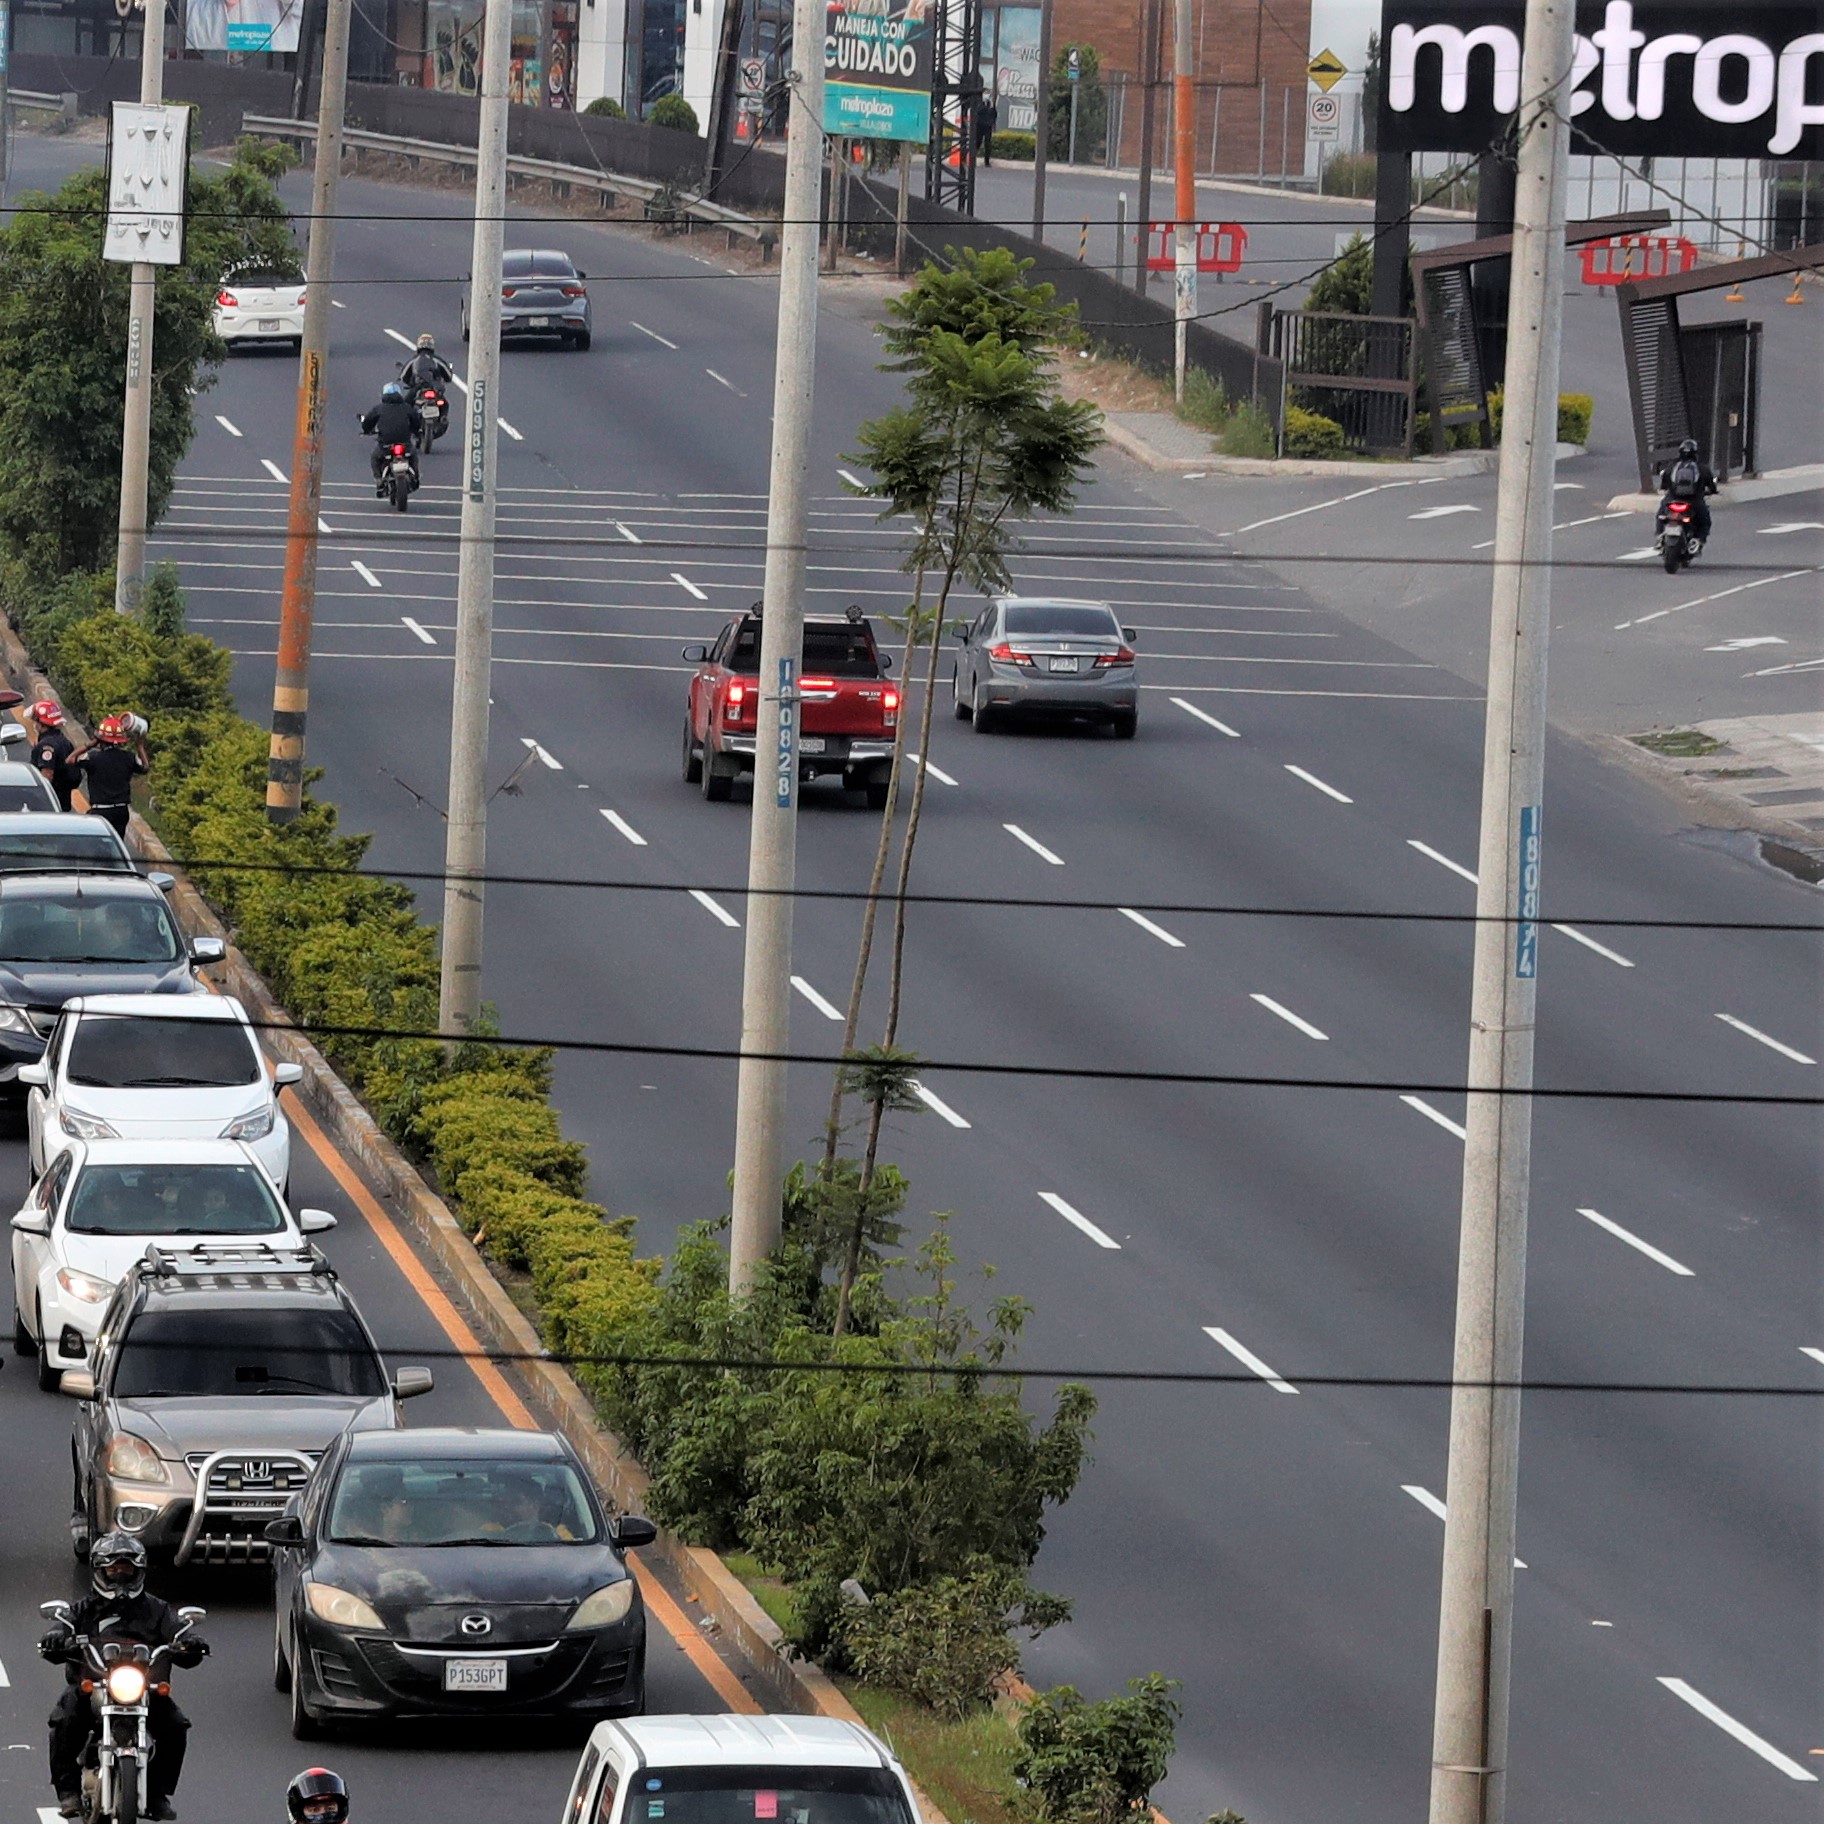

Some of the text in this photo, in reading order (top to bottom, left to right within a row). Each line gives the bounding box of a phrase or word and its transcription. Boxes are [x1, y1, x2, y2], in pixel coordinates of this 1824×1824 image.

[834, 15, 906, 40] MANEJA CON
[824, 35, 917, 77] CUIDADO
[1316, 102, 1332, 112] 20
[472, 382, 484, 483] 509869
[450, 1668, 504, 1684] P153GPT
